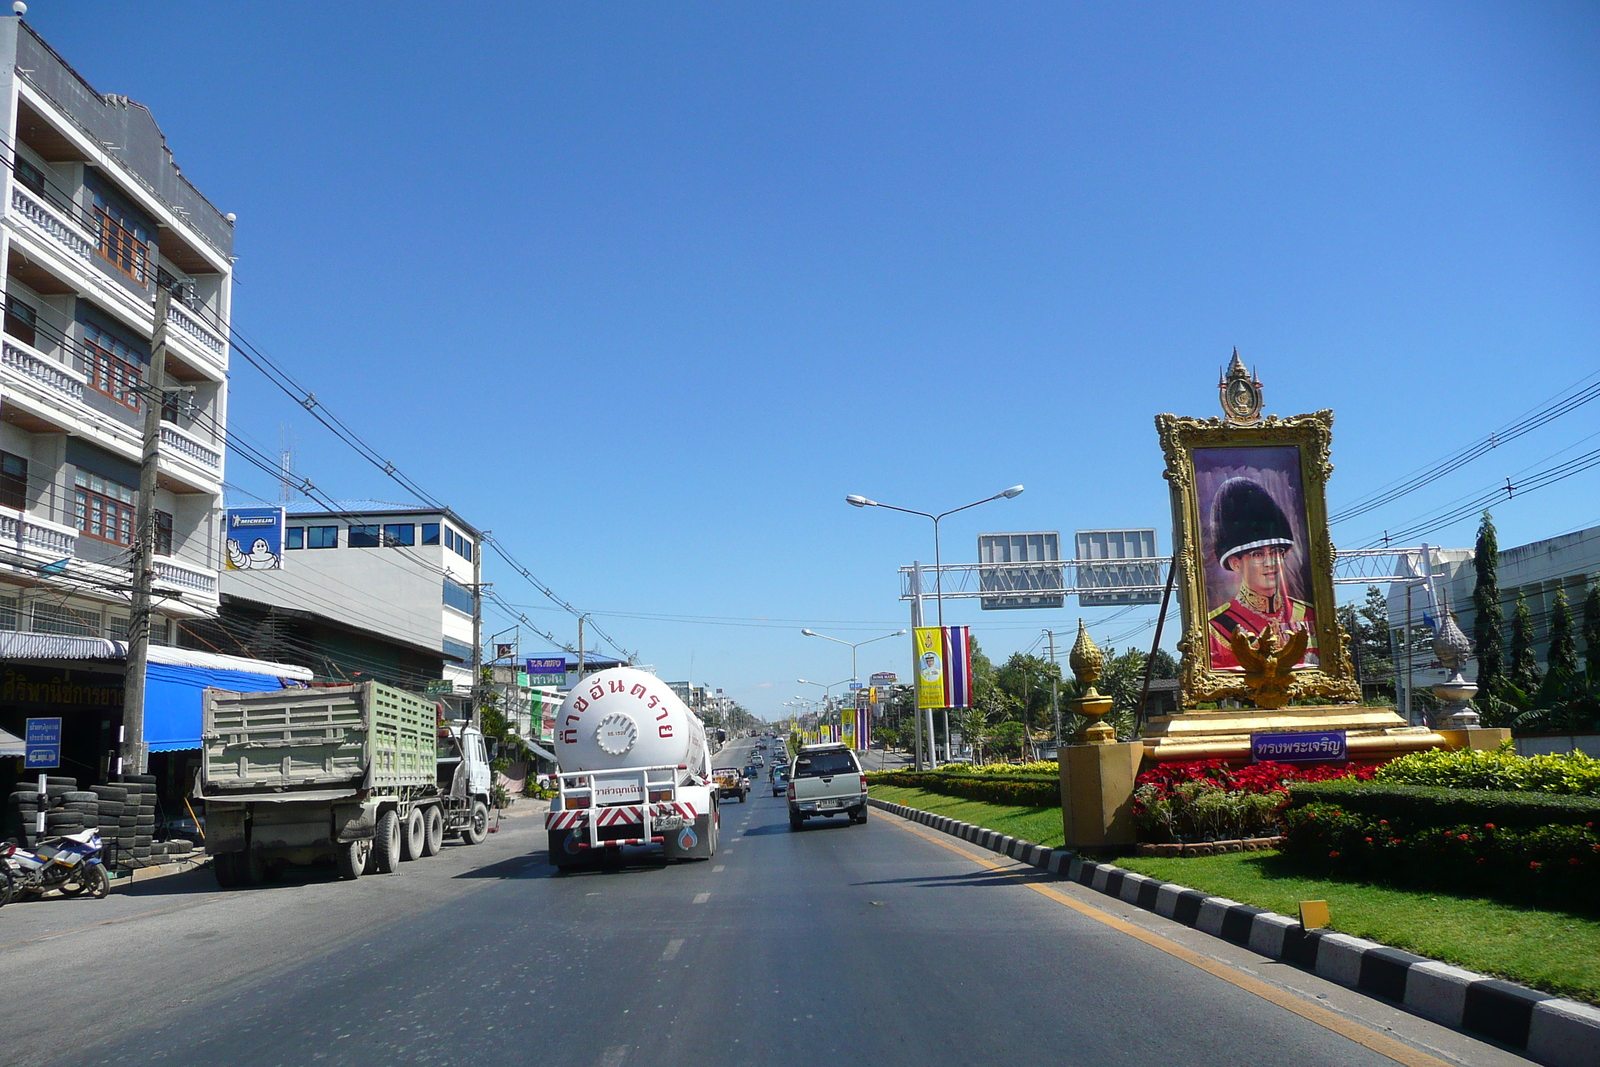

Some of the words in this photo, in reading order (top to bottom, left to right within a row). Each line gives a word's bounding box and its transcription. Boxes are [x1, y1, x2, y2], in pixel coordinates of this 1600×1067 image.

[1257, 737, 1341, 755] ทรงพระเจริญ
